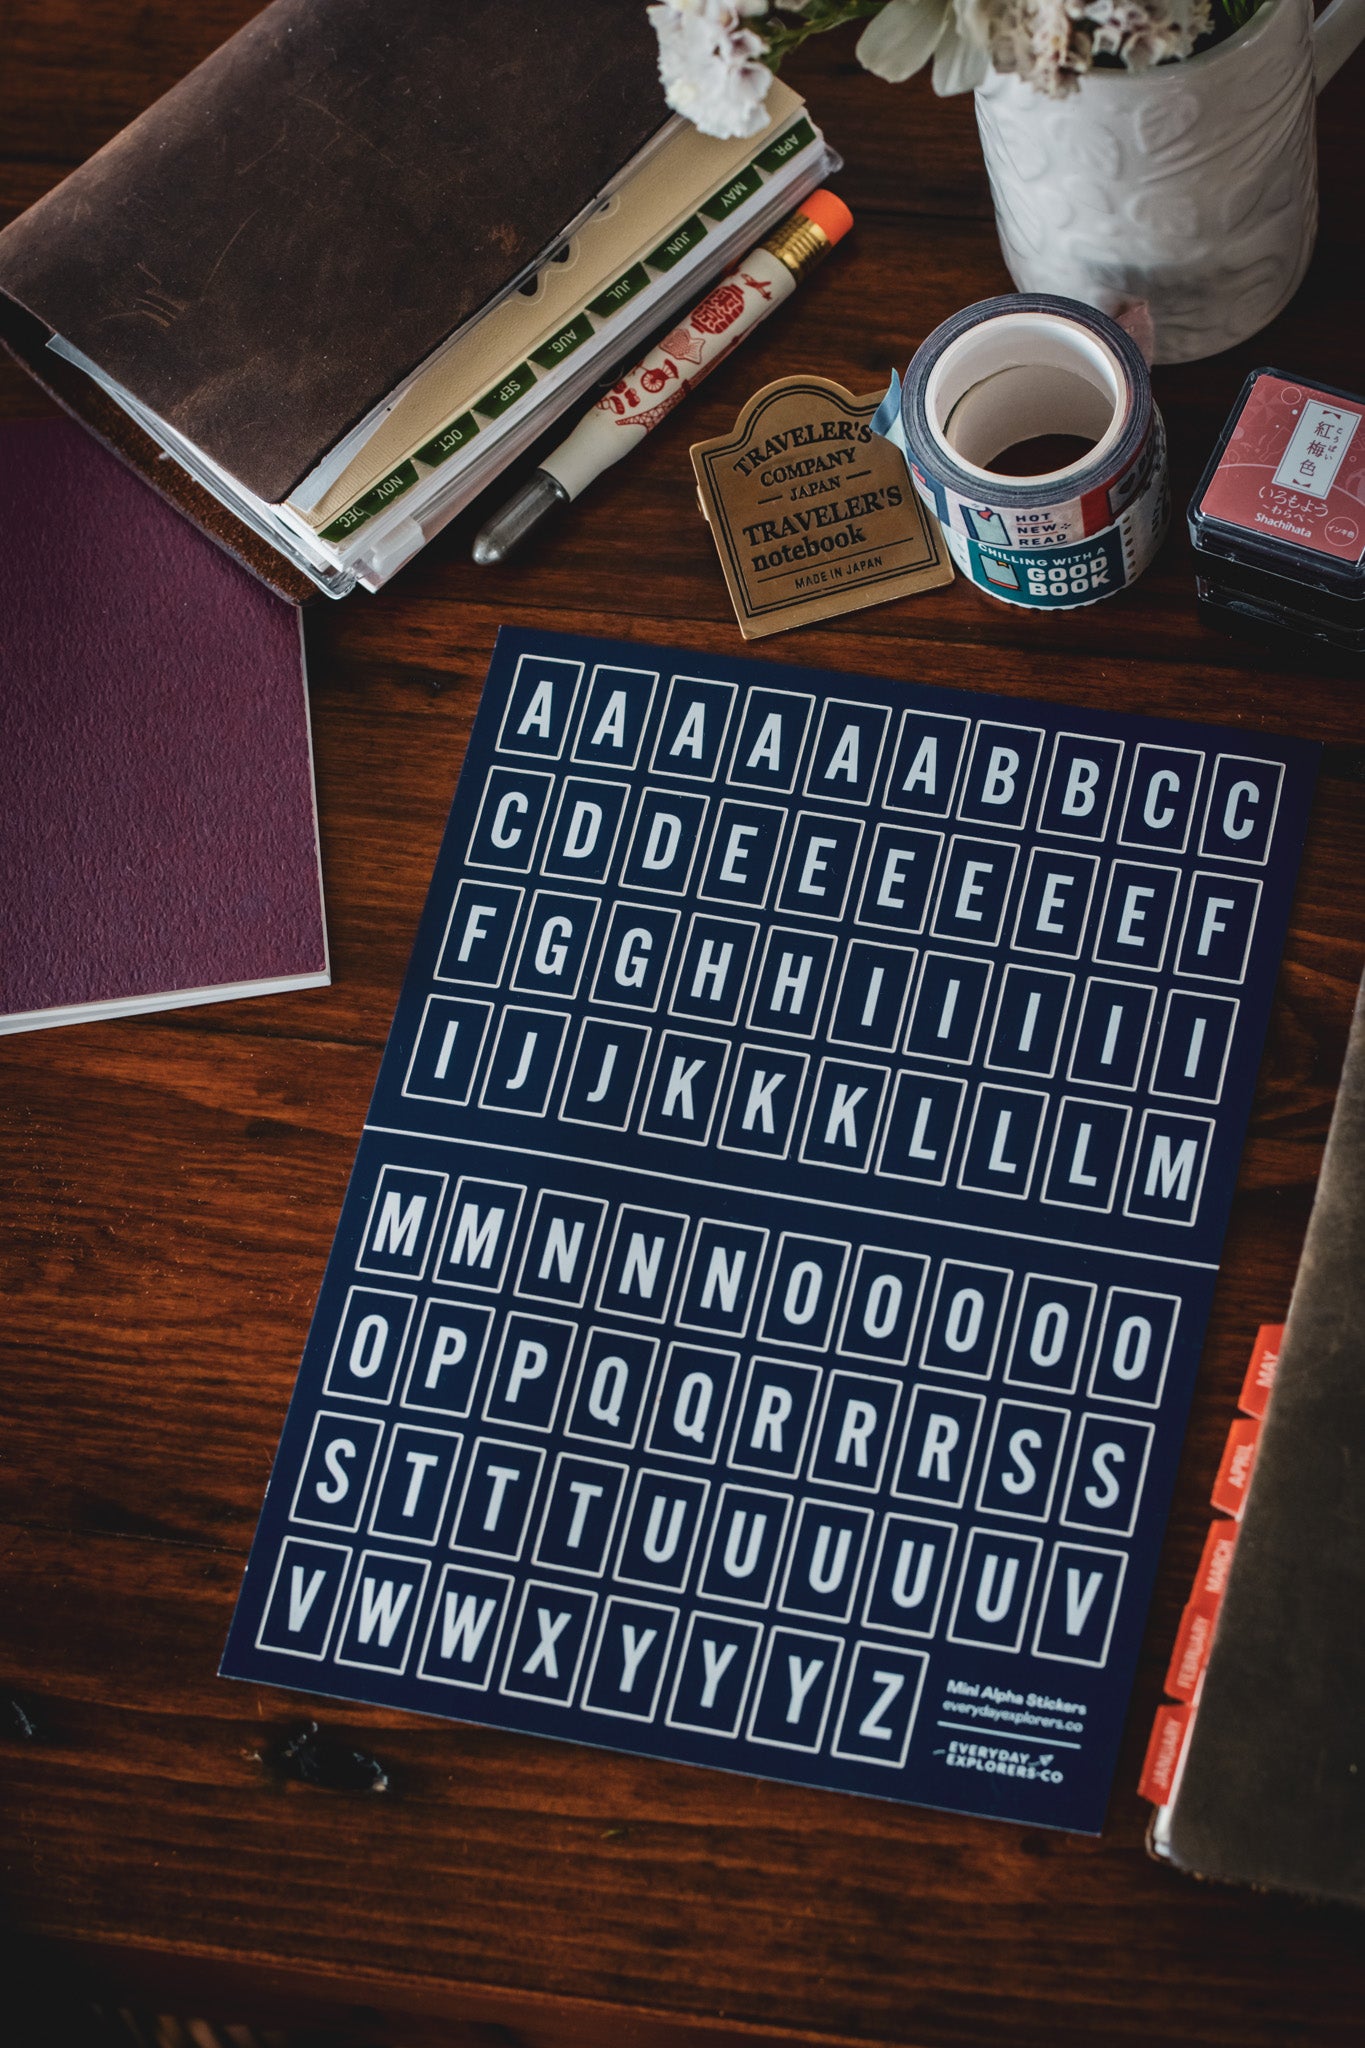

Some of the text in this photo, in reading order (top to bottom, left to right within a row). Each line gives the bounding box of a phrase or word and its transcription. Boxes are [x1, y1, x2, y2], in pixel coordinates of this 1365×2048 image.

[771, 133, 799, 156] APR.
[723, 181, 748, 208] MAY
[663, 231, 690, 255] JUN.
[548, 328, 577, 353] AUG.
[493, 380, 521, 402] SEP.
[434, 428, 463, 451] OCT.
[732, 421, 873, 477] TRAVELER'S
[1324, 427, 1343, 460] こうばい
[760, 447, 857, 487] COMPANY
[372, 475, 404, 500] NOV.
[790, 475, 841, 501] JAPAN
[1258, 486, 1329, 517] いろもよう
[336, 506, 366, 528] DEC.
[743, 485, 903, 548] TRAVELER'S
[1015, 512, 1052, 522] HOT
[1017, 523, 1058, 534] NEW
[1254, 511, 1313, 539] Shachihata
[751, 525, 867, 573] notebook
[977, 543, 1106, 567] CHILLING WITH A
[1019, 533, 1067, 546] READ
[794, 556, 883, 589] MADE IN JAPAN
[1027, 556, 1108, 582] GOOD
[1028, 569, 1111, 597] BOOK
[516, 680, 1260, 840] A A A A A A B B C C
[490, 791, 1235, 956] C D D E E E E E E F
[457, 904, 1207, 1078] F G G H H I I I I I
[433, 1020, 1198, 1202] I J J K K K L L L M
[371, 1190, 1152, 1381] M M N N N O O O O O
[1255, 1350, 1279, 1389] MAY
[349, 1314, 1126, 1509] O P P Q Q R R R S S
[1227, 1443, 1256, 1490] APRIL
[315, 1438, 1103, 1636] S T T T U U U U U V
[1205, 1538, 1233, 1594] MARCH
[288, 1565, 905, 1741] V W W X Y Y Y Z
[946, 1679, 1088, 1716] Mini Alpha Stickers
[942, 1699, 1084, 1733] everydayexplorers.co
[948, 1740, 1031, 1765] EVERYDAY
